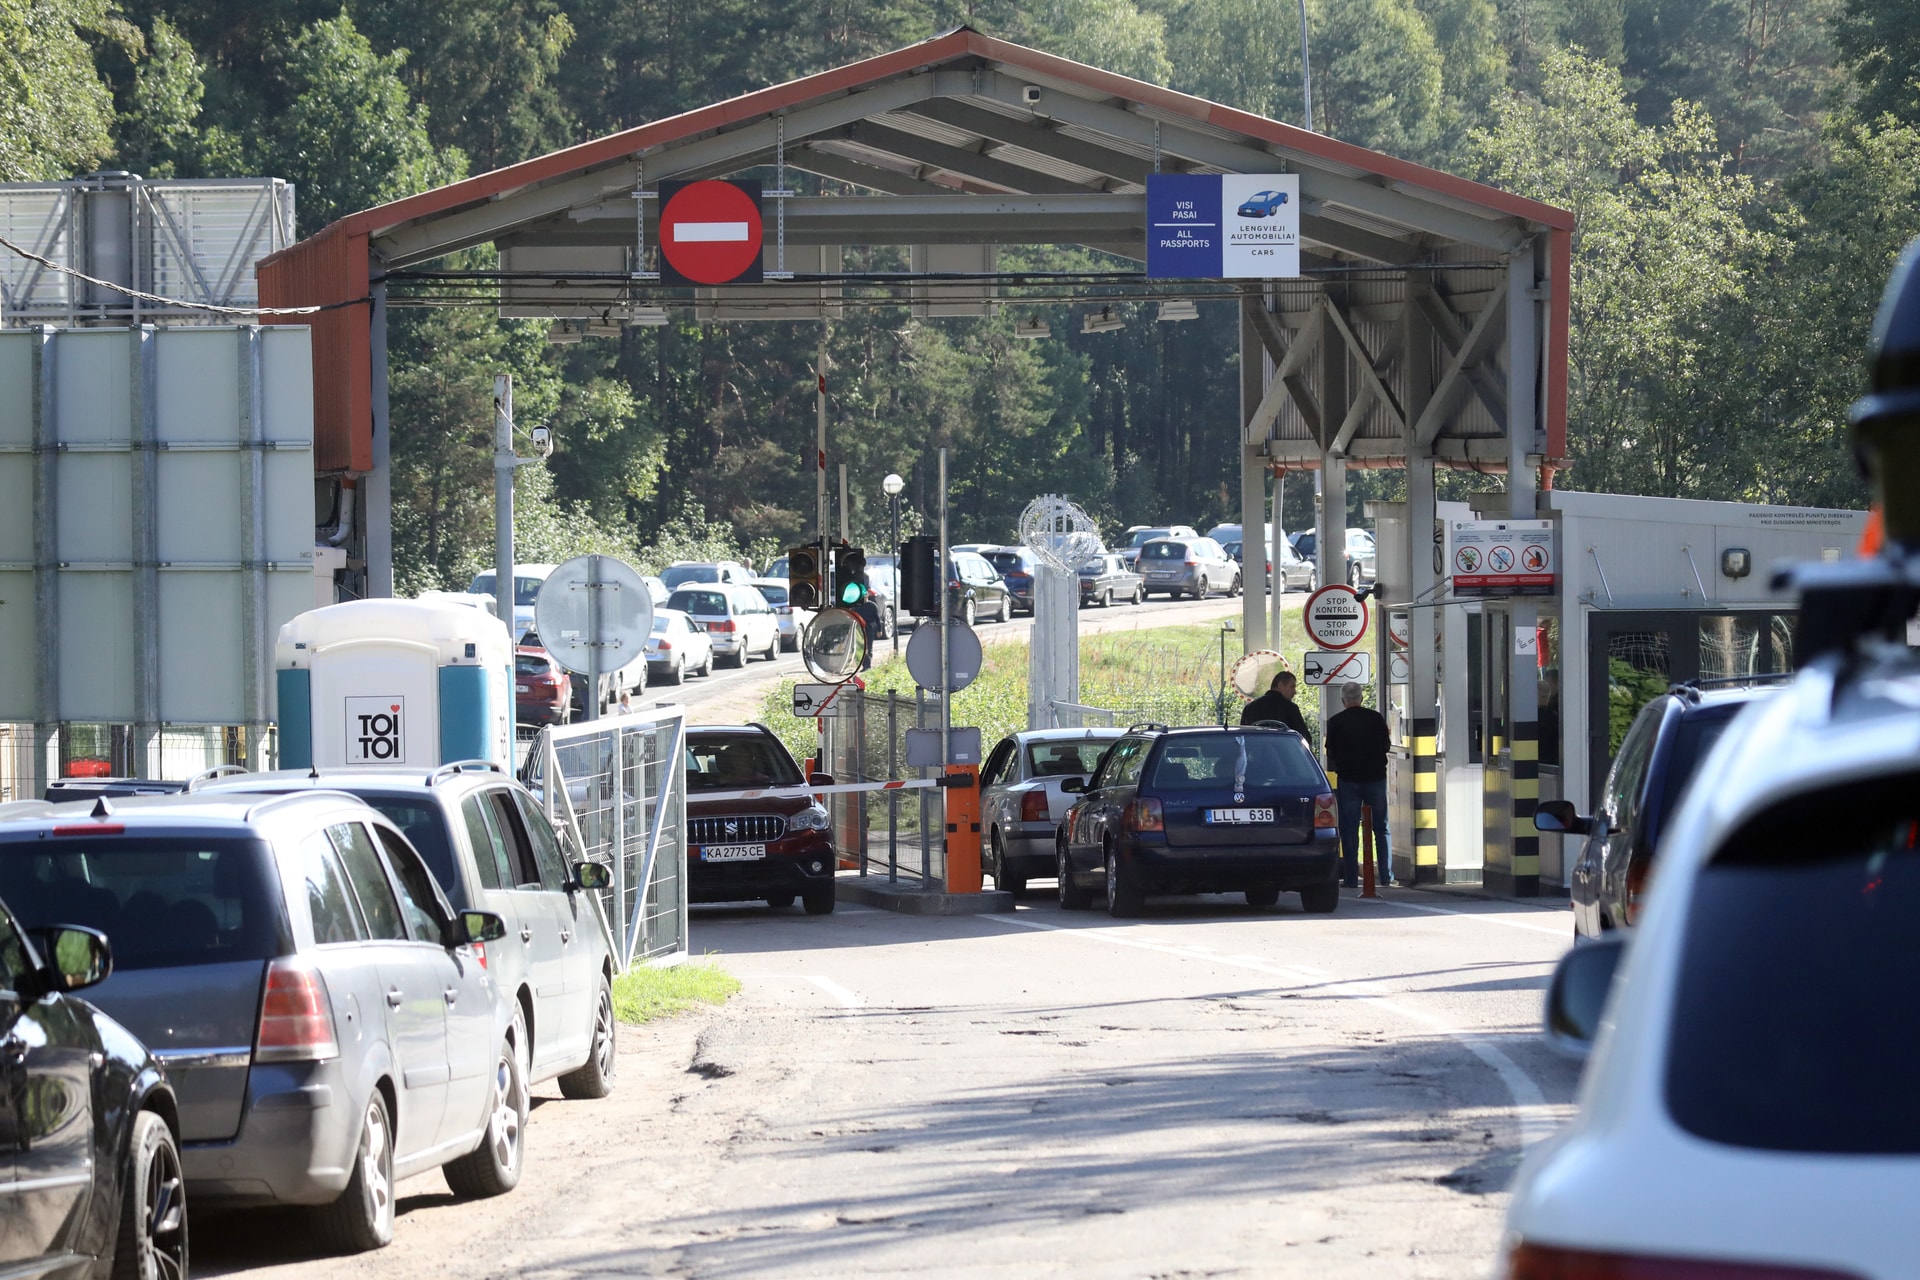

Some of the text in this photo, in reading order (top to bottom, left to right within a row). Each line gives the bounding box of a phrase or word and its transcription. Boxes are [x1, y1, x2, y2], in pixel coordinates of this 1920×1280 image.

[1176, 201, 1193, 210] VISI
[1172, 210, 1197, 219] PASAI
[1177, 230, 1193, 238] ALL
[1160, 239, 1210, 248] PASSPORTS
[1326, 597, 1347, 605] STOP
[1315, 605, 1357, 614] KONTROLĖ
[1318, 629, 1355, 637] CONTROL
[358, 736, 399, 759] TOI
[1213, 809, 1273, 822] LLL 636
[706, 848, 722, 858] KA
[723, 846, 748, 858] 2775
[749, 845, 765, 857] CE
